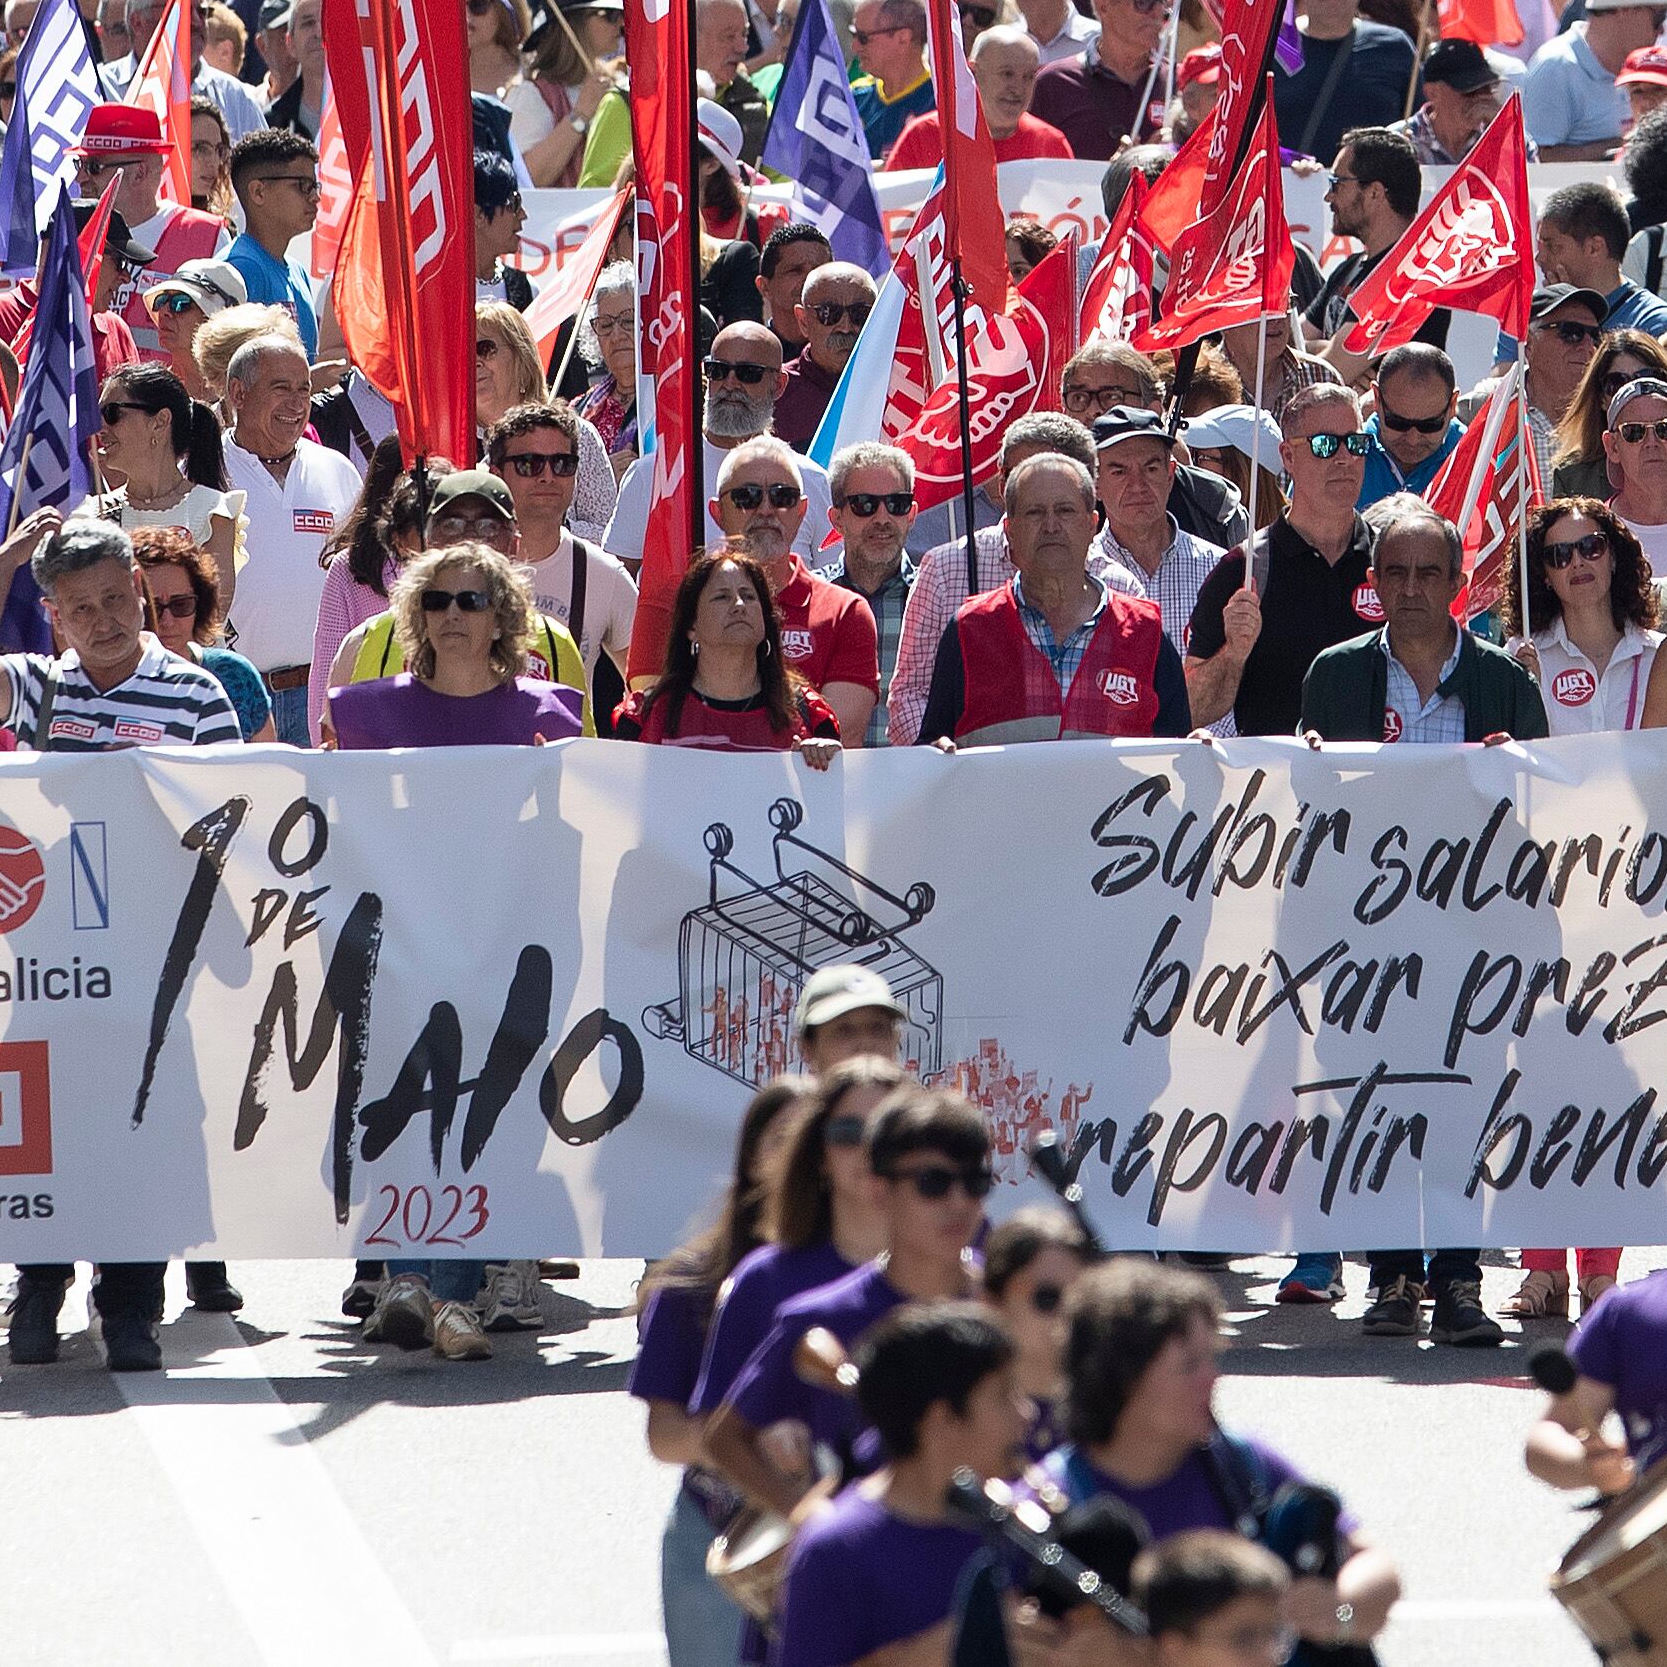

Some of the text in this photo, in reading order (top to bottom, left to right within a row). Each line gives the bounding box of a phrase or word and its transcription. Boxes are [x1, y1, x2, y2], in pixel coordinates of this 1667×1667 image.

[294, 515, 334, 529] CCOO
[1103, 673, 1138, 695] UGT
[1556, 672, 1594, 693] UGT
[53, 721, 96, 736] CCOO
[117, 724, 161, 741] CCOO
[1090, 768, 1352, 900] Subir
[245, 884, 332, 949] DE
[1121, 914, 1424, 1046] baixar
[1071, 1060, 1473, 1227] repartir
[366, 1186, 490, 1245] 2023
